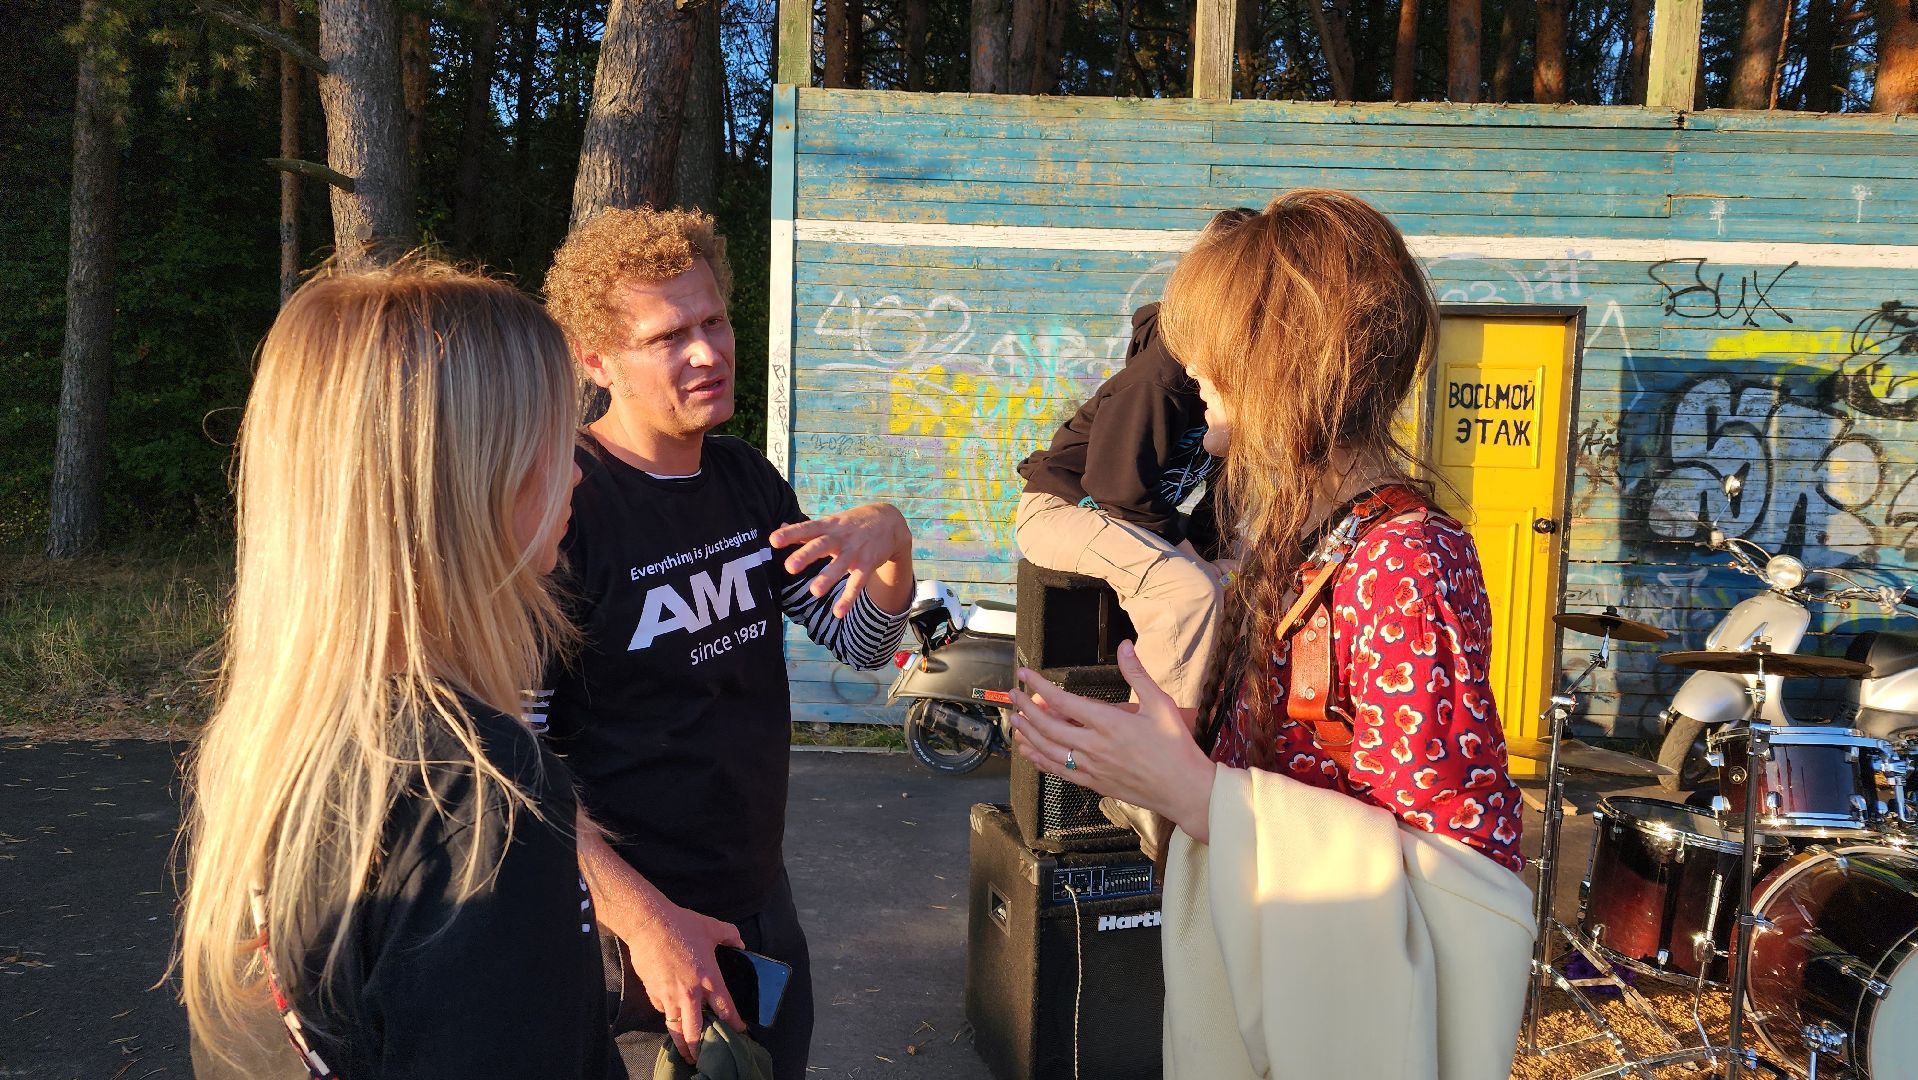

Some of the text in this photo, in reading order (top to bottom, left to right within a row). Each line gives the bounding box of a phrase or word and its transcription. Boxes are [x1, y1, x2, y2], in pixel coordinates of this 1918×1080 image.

[1448, 380, 1535, 410] ВОСЬМОЙ
[1455, 417, 1532, 446] ЭТАЖ
[630, 552, 694, 581] Everything
[693, 547, 702, 560] is
[704, 541, 724, 560] just
[627, 547, 773, 651] AMT
[690, 620, 767, 666] since 1987
